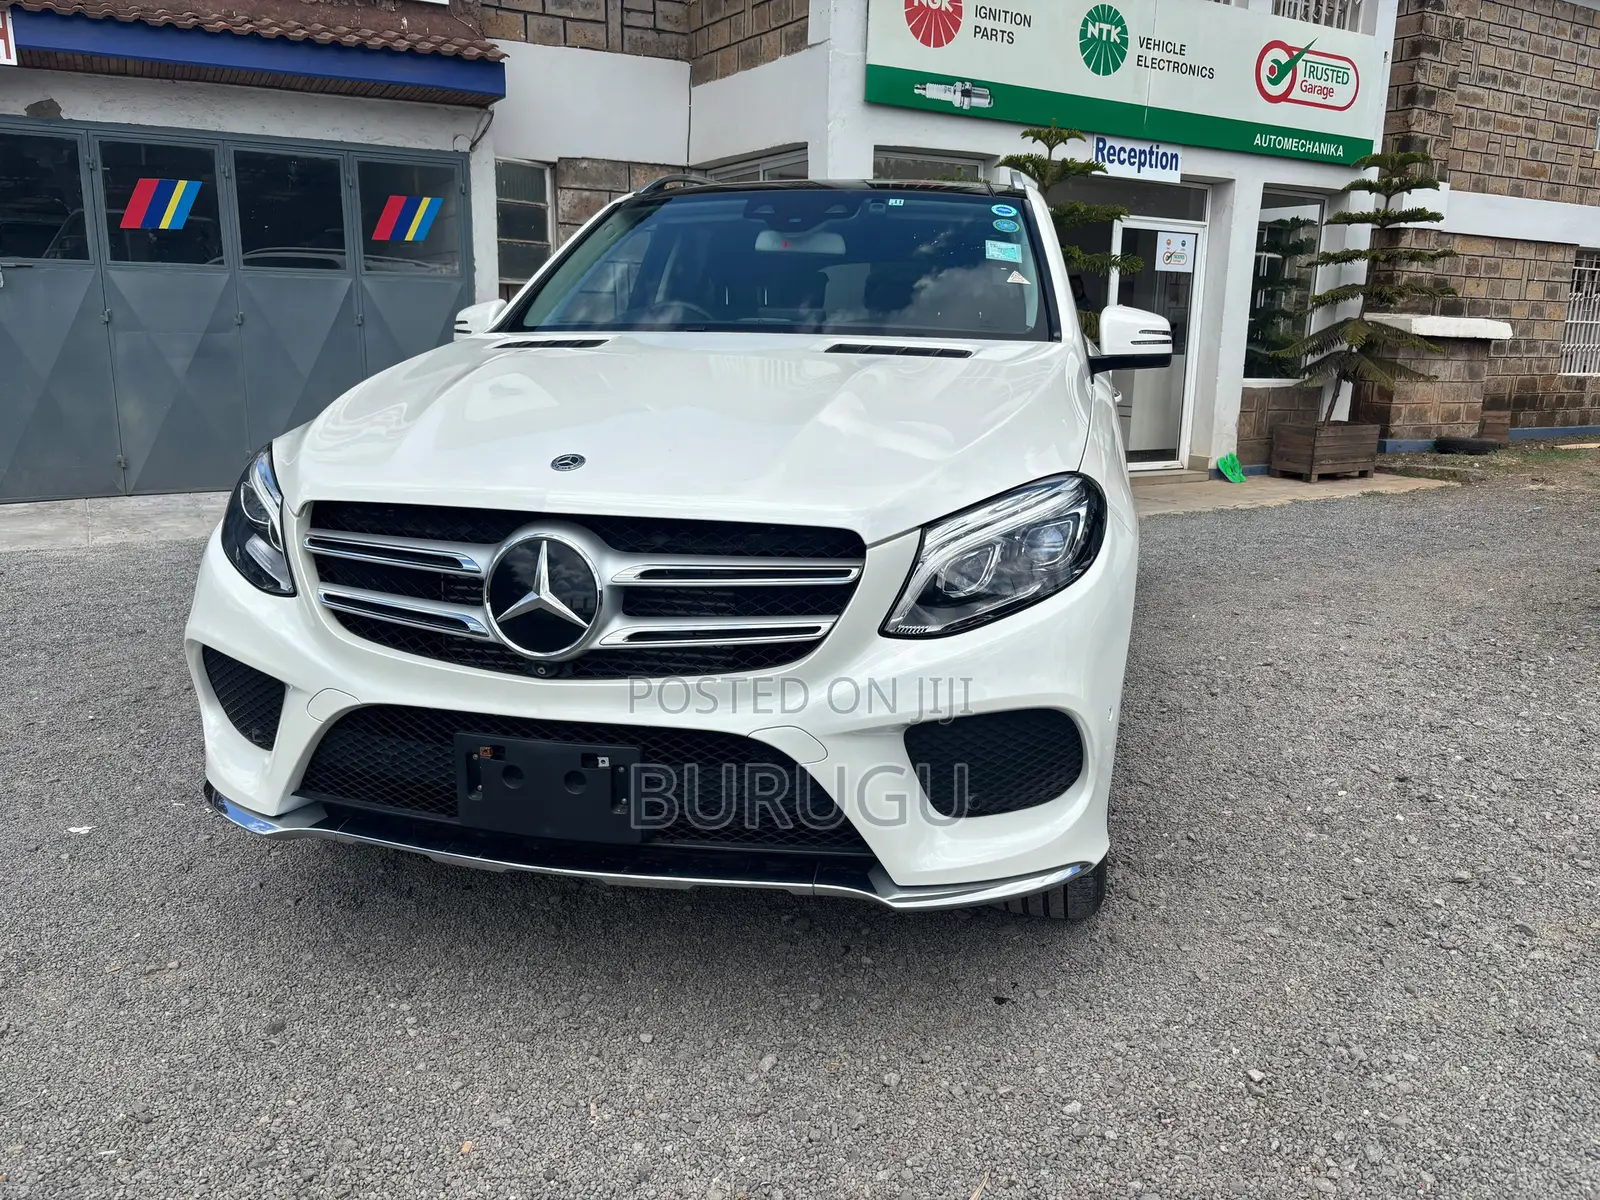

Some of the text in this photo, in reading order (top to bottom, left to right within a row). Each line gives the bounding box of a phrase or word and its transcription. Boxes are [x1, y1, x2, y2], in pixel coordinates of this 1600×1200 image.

[974, 5, 1032, 28] IGNITION
[973, 25, 1015, 45] PARTS
[1087, 21, 1122, 44] NTK
[1138, 36, 1187, 56] VEHICLE
[1136, 55, 1215, 80] ELECTRONICS
[1301, 59, 1350, 85] TRUSTED
[1300, 79, 1335, 100] Garage
[1094, 136, 1179, 173] Reception
[1253, 133, 1344, 157] AUTOMECHANIKA
